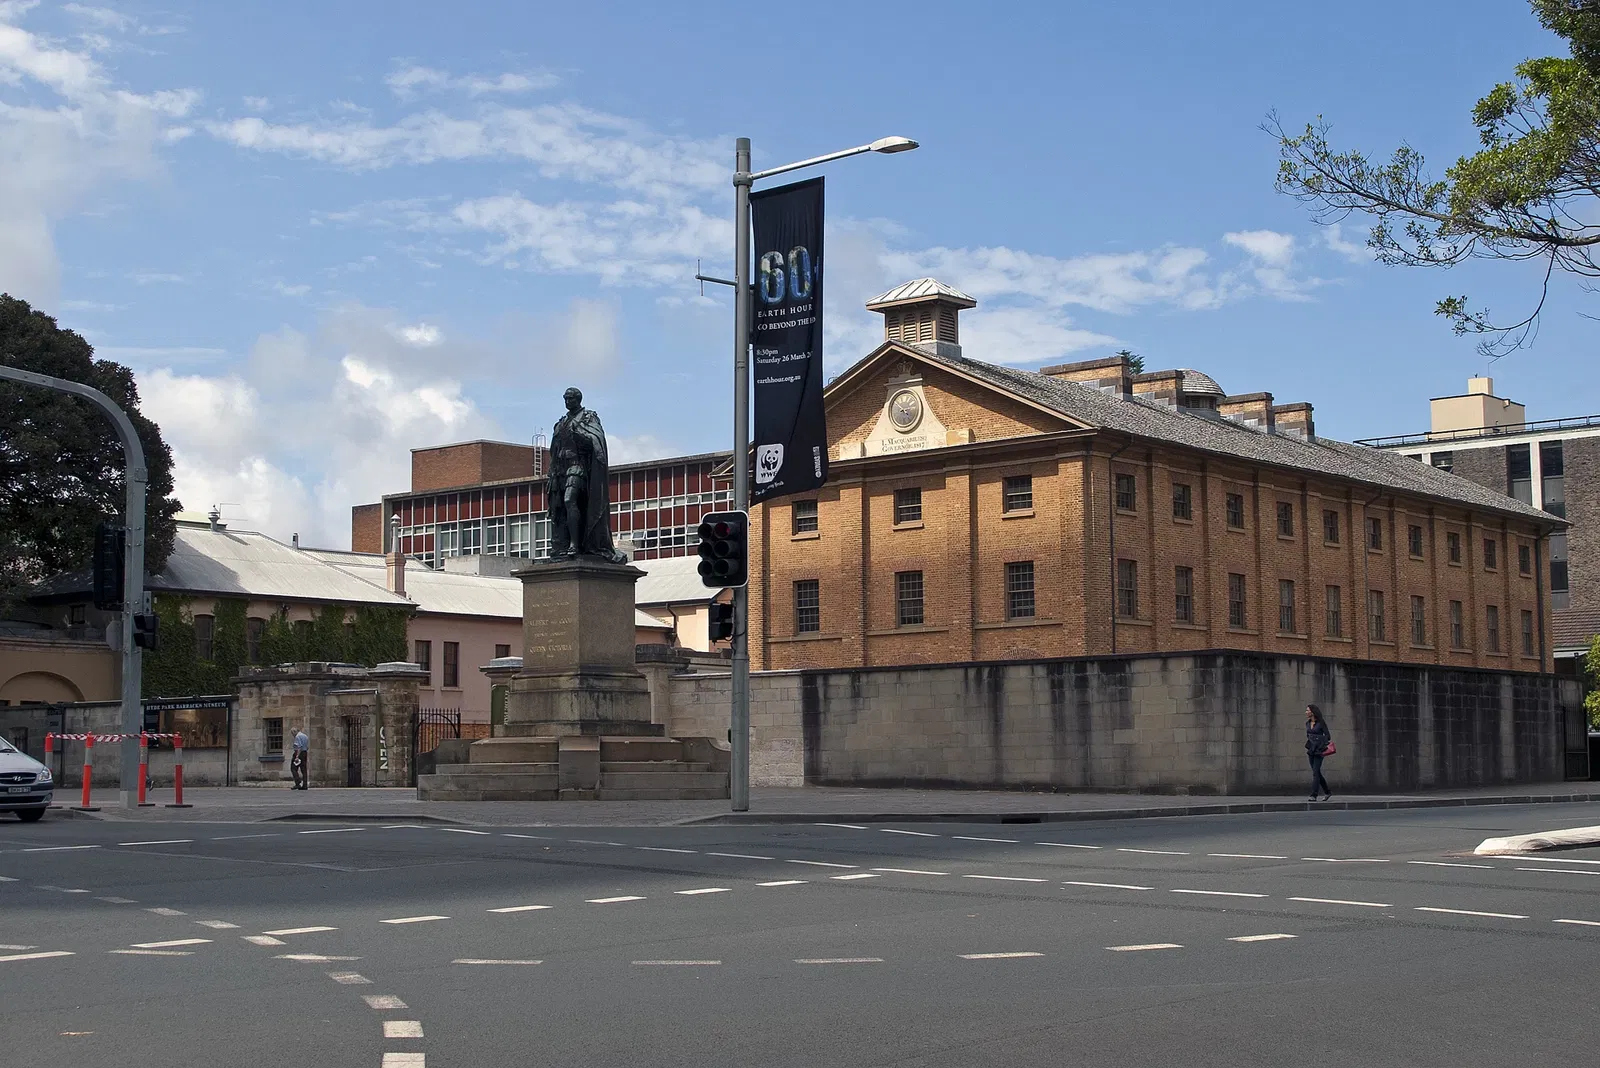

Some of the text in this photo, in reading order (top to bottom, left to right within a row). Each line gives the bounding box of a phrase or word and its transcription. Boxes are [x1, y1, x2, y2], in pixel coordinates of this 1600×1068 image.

[757, 304, 813, 318] EARTH HOUR
[769, 320, 797, 330] BEYOND
[797, 317, 810, 326] THE
[756, 349, 779, 357] 8:30pm
[756, 356, 781, 365] Saturday
[782, 354, 790, 362] 26
[790, 351, 806, 361] March
[756, 375, 802, 384] earthhour.org.au
[761, 470, 778, 478] WWF
